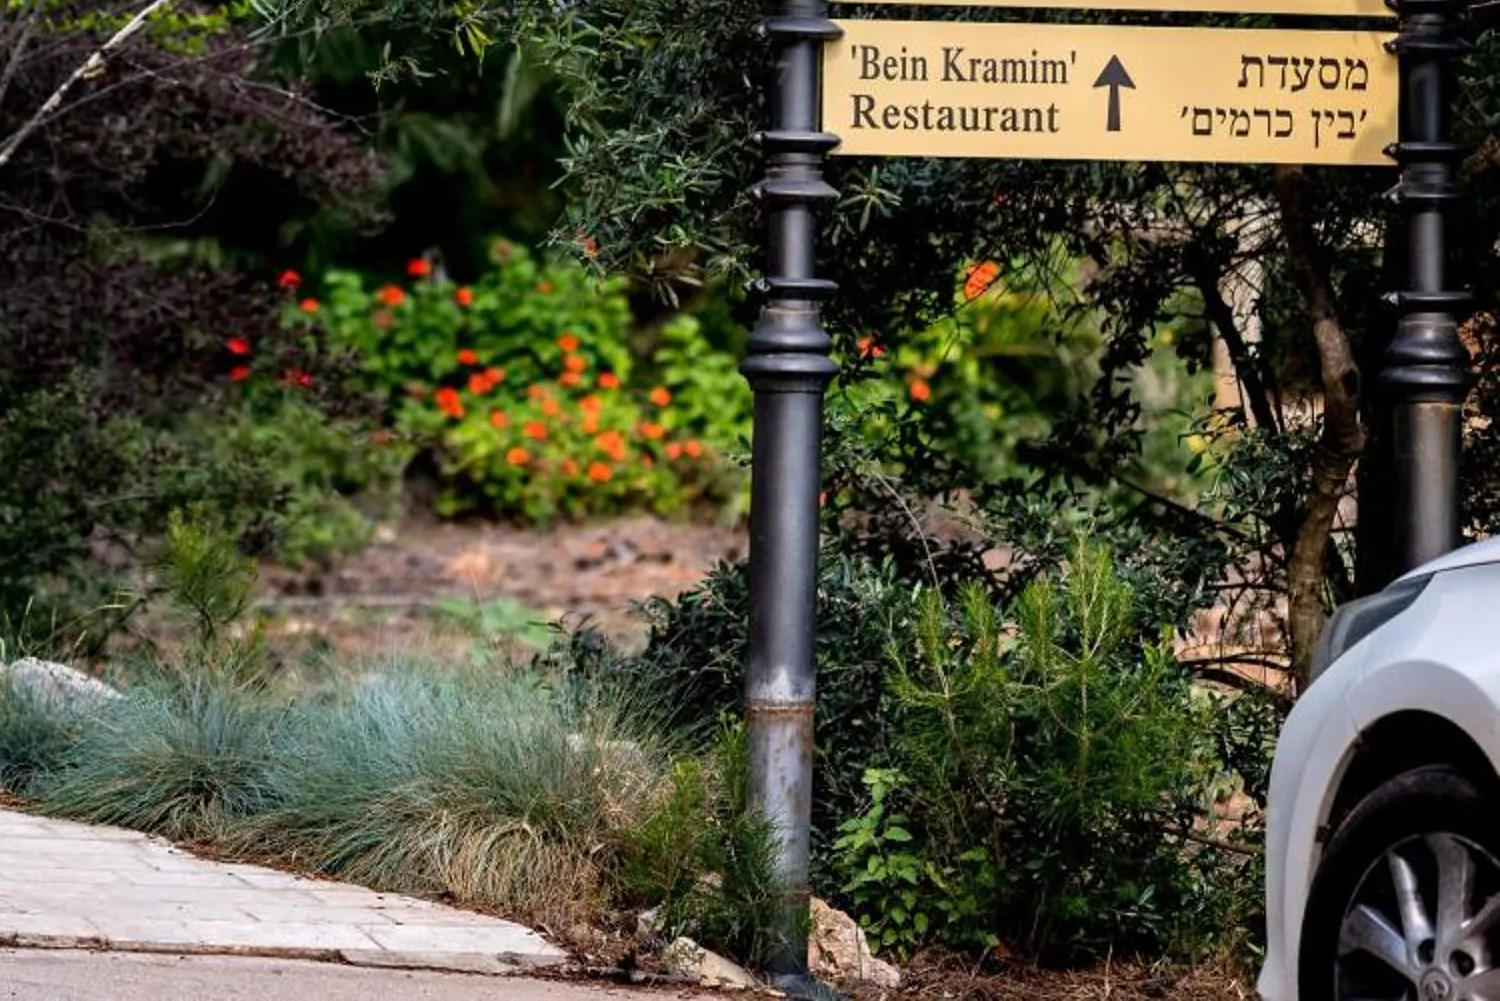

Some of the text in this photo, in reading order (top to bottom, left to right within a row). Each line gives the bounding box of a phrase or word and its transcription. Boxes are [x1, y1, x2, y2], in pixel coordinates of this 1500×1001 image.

[851, 45, 1076, 84] 'Bein Kramim'
[1237, 54, 1369, 93] מסעדת
[851, 94, 1059, 133] Restaurant
